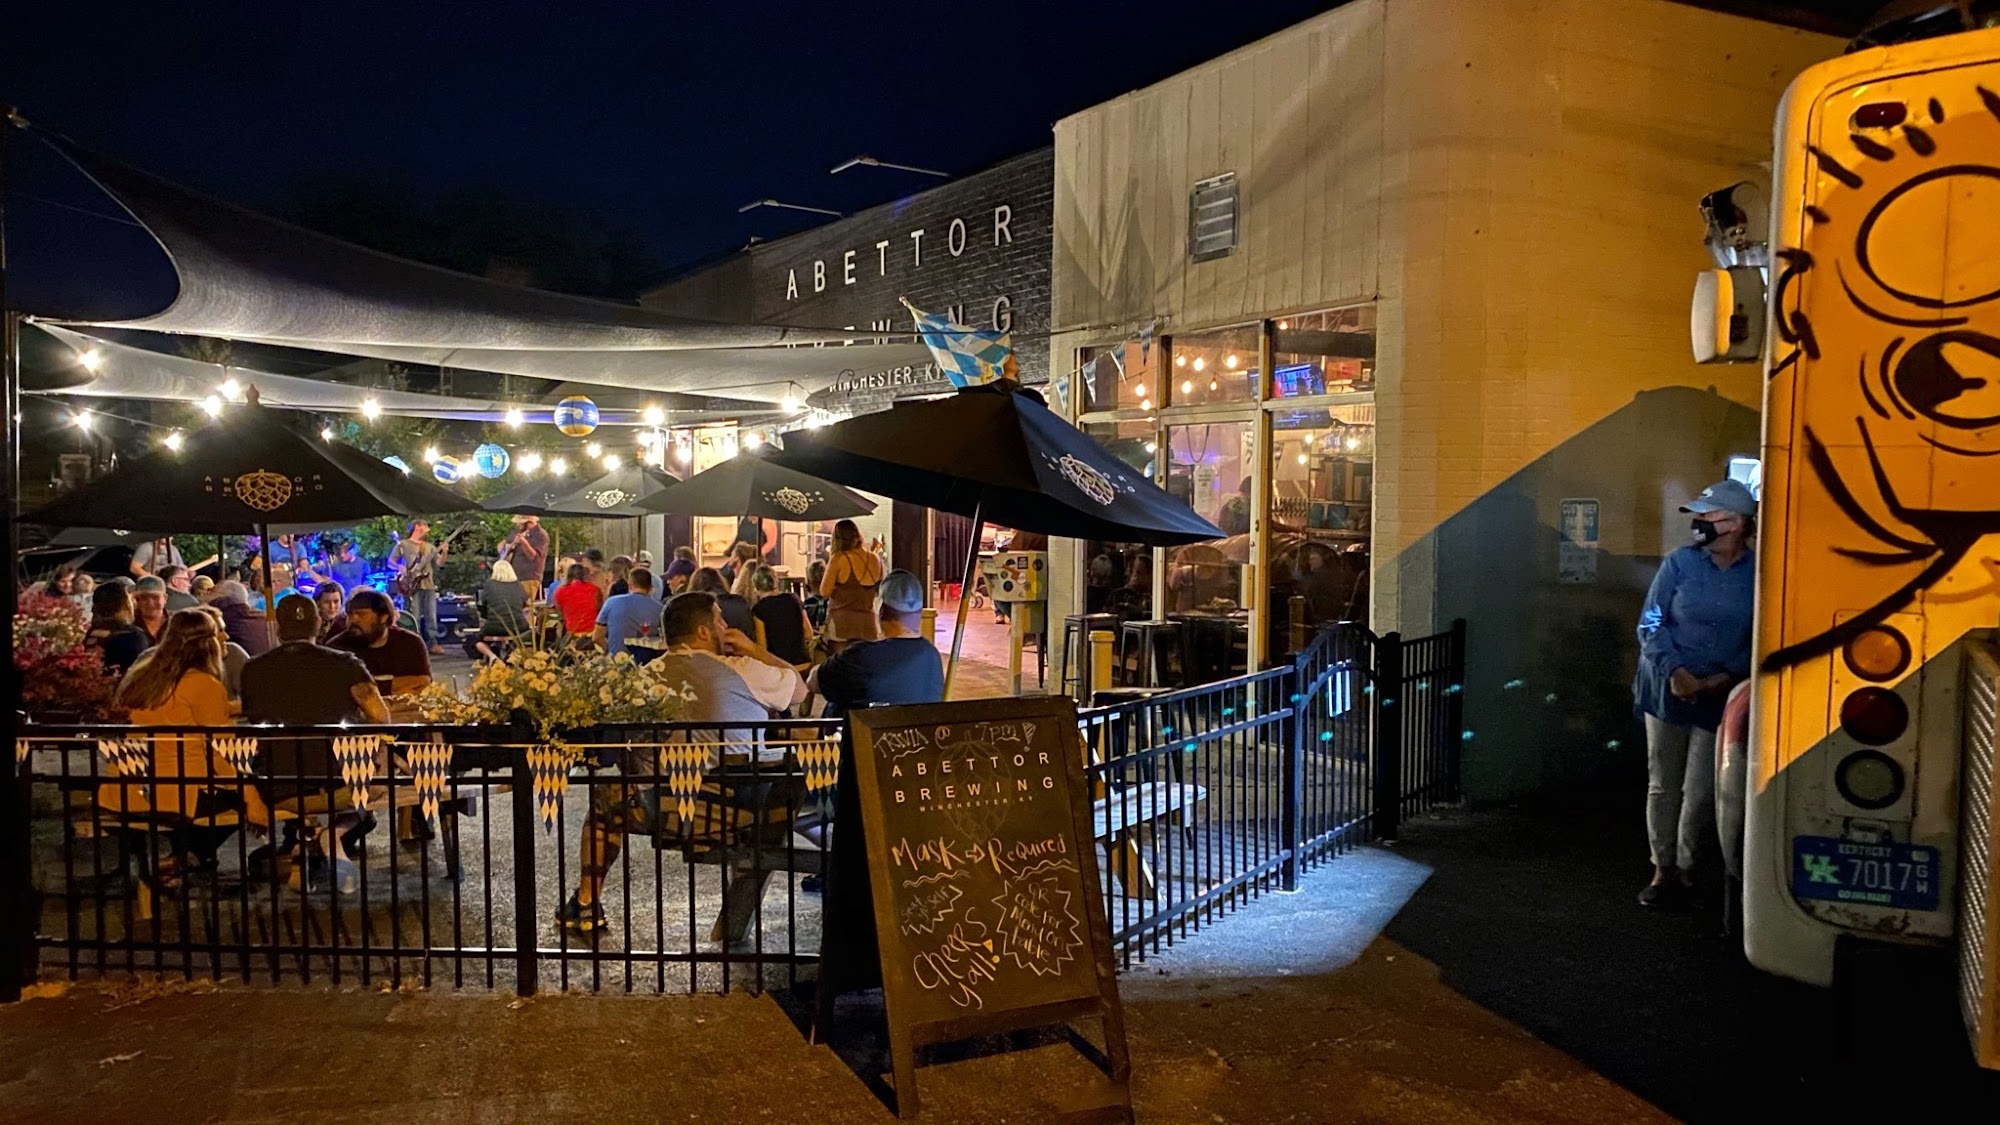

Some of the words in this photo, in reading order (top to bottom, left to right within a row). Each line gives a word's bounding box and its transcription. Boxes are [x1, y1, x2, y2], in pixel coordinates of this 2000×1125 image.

[786, 204, 1012, 300] ABETTOR
[874, 728, 929, 758] TRIVIA
[935, 725, 951, 749] @
[892, 751, 1049, 778] ABETTOR
[895, 776, 1054, 803] BREWING
[1847, 858, 1912, 892] 7017
